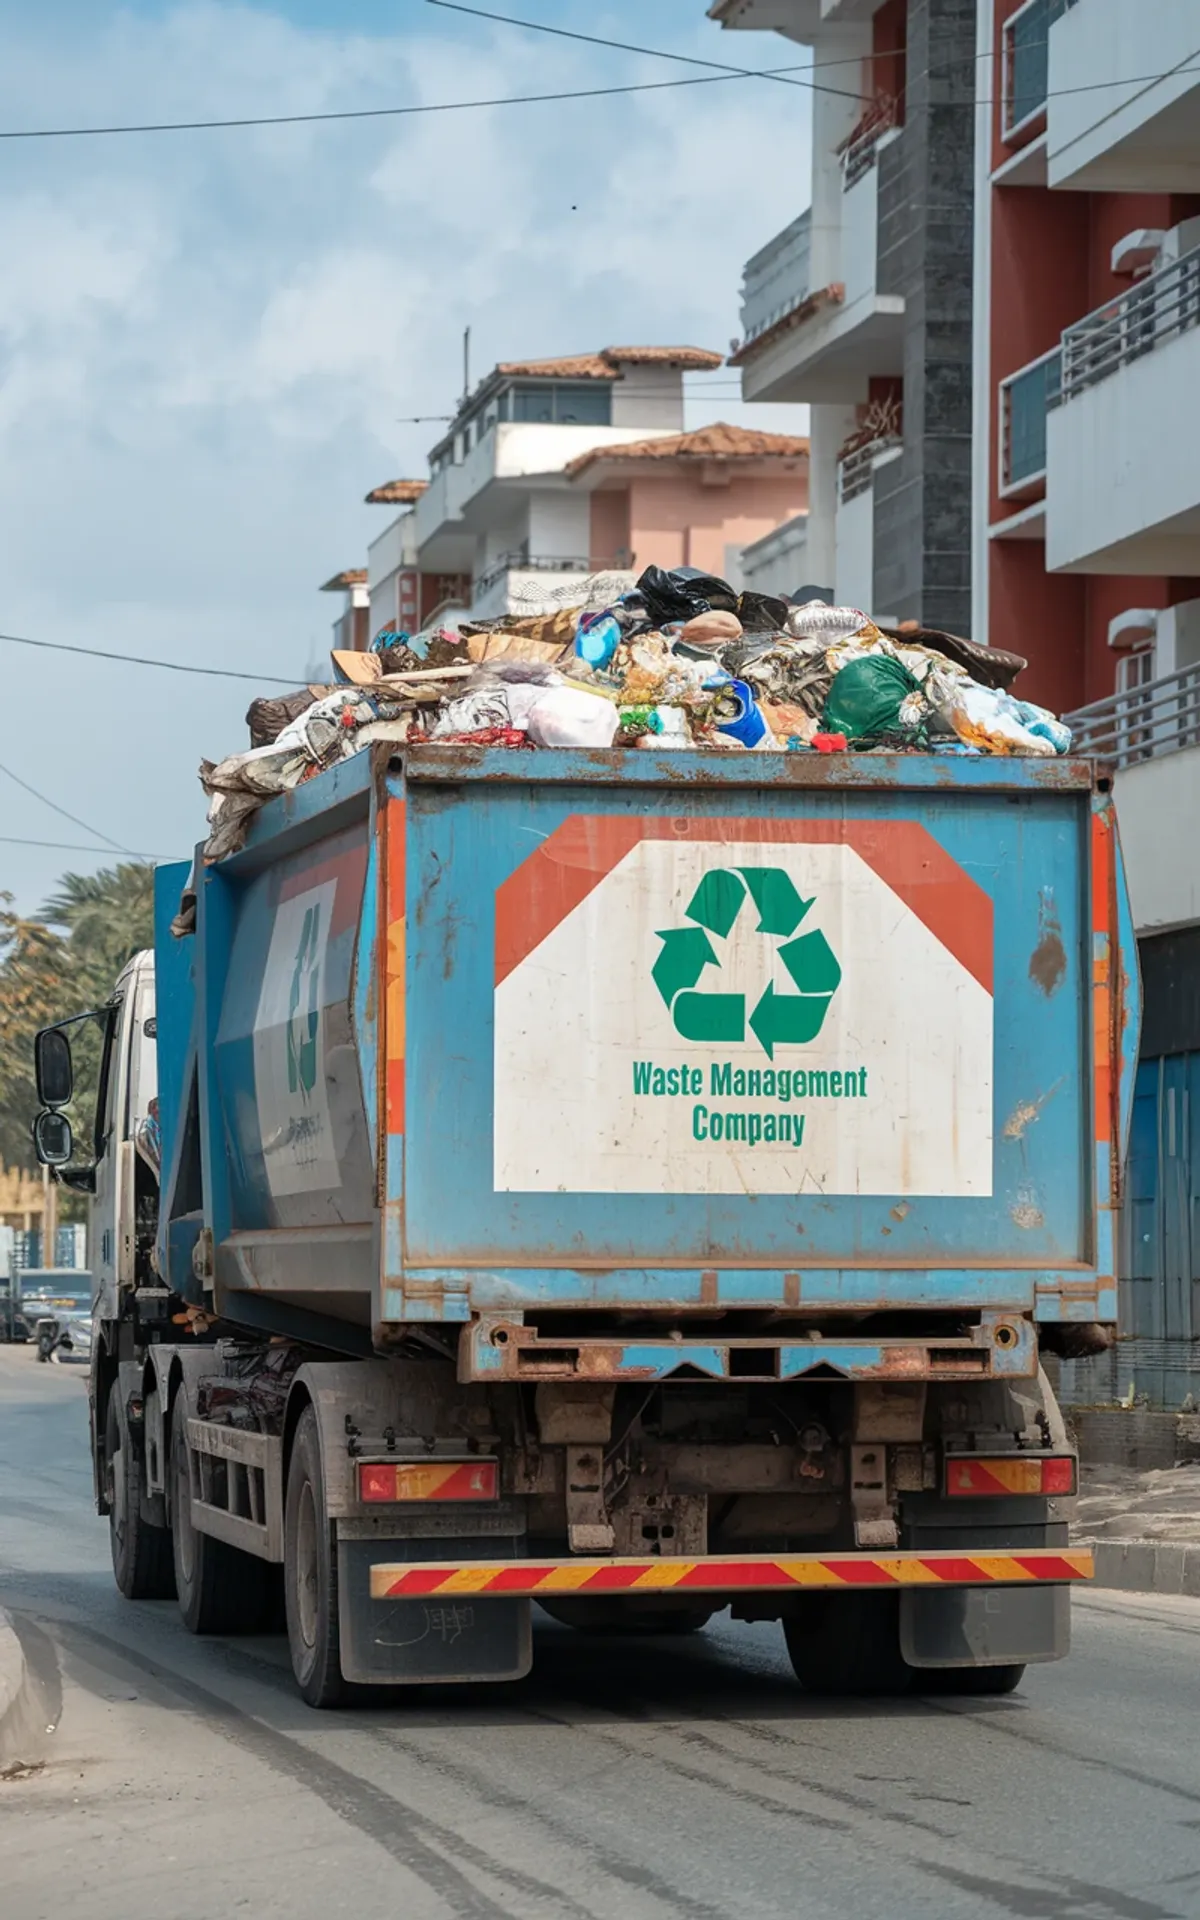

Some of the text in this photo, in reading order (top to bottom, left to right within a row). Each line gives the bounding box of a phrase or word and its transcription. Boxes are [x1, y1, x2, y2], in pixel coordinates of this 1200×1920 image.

[633, 1061, 868, 1102] Waste Management
[692, 1104, 806, 1147] Company
